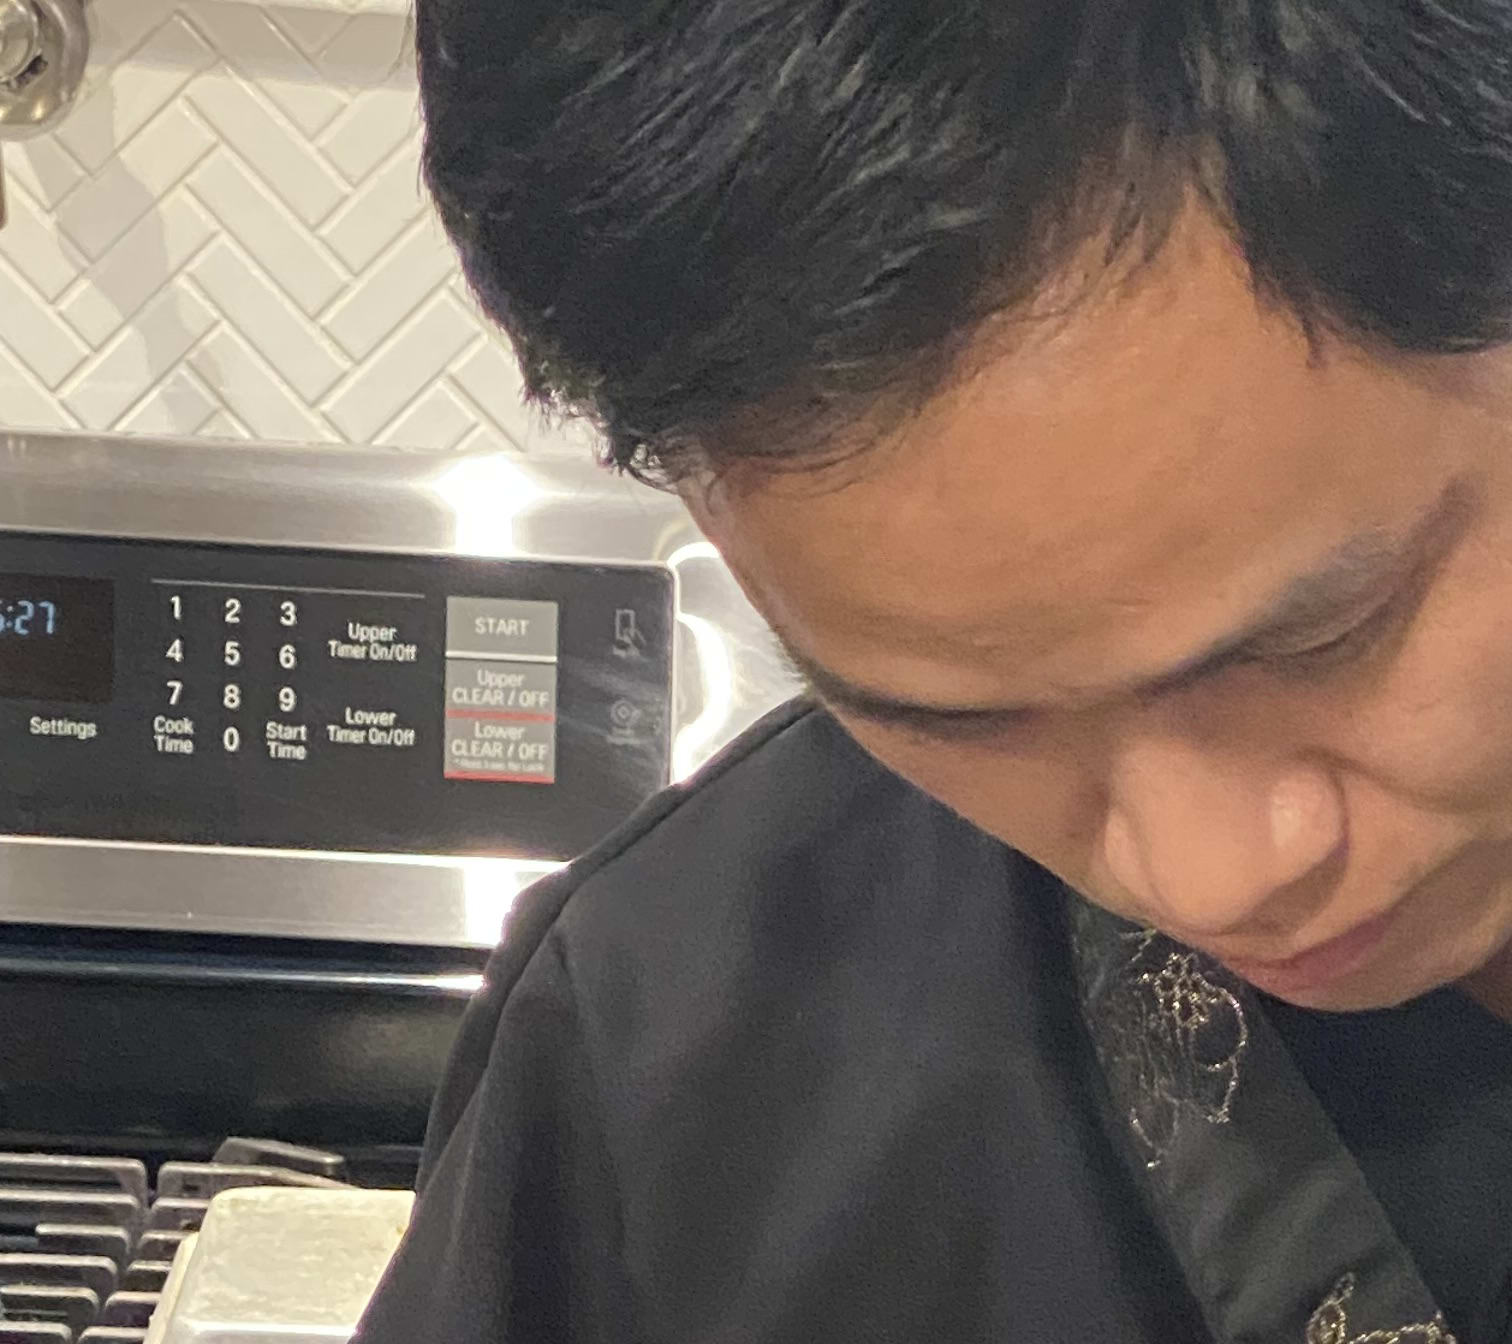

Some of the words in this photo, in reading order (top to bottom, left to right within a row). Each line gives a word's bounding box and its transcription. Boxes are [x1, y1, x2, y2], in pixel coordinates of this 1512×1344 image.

[0, 600, 56, 635] :27
[169, 595, 182, 621] 1
[224, 598, 242, 624] 2
[279, 601, 298, 627] 3
[347, 621, 397, 642] Upper
[474, 616, 530, 636] START
[165, 638, 184, 663] 4
[224, 641, 241, 666] 5
[278, 644, 297, 669] 6
[328, 640, 366, 659] Timer
[477, 669, 525, 688] Upper
[166, 680, 183, 705] 7
[223, 684, 241, 710] 8
[278, 686, 297, 712] 9
[451, 687, 504, 706] CLEAR
[518, 689, 549, 708] OFF
[153, 714, 194, 735] Cook
[345, 706, 397, 726] Lower
[29, 715, 98, 740] Settings
[266, 720, 308, 742] Start
[326, 724, 366, 743] Timer
[474, 721, 526, 740] Lower
[153, 734, 194, 754] Time
[223, 726, 240, 752] 0
[266, 740, 308, 760] Time
[451, 739, 503, 758] CLEAR
[518, 742, 549, 761] OFF
